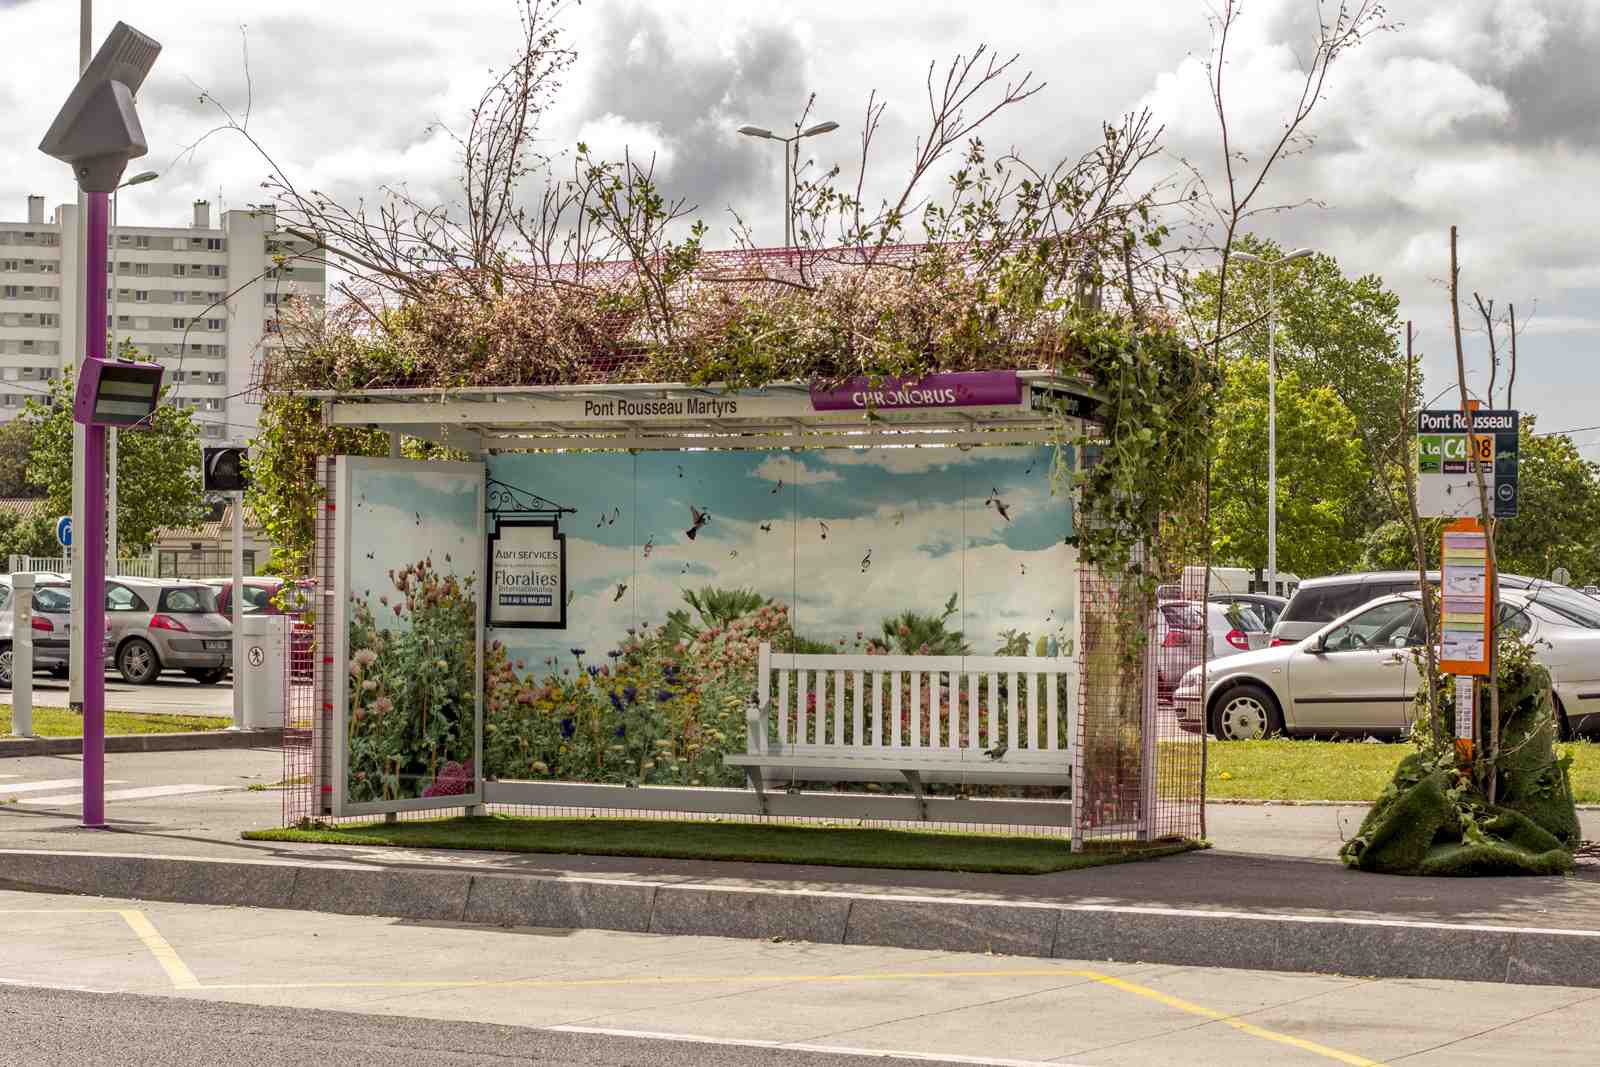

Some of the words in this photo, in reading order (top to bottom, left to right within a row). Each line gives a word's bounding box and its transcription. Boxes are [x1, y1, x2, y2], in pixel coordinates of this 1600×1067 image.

[852, 388, 956, 407] CHRONOBUS
[585, 400, 614, 416] Pont
[618, 399, 683, 416] Rousseau
[687, 398, 737, 418] Martyrs
[1421, 414, 1452, 429] Pont
[1444, 438, 1466, 459] C4
[495, 568, 558, 586] Floralies
